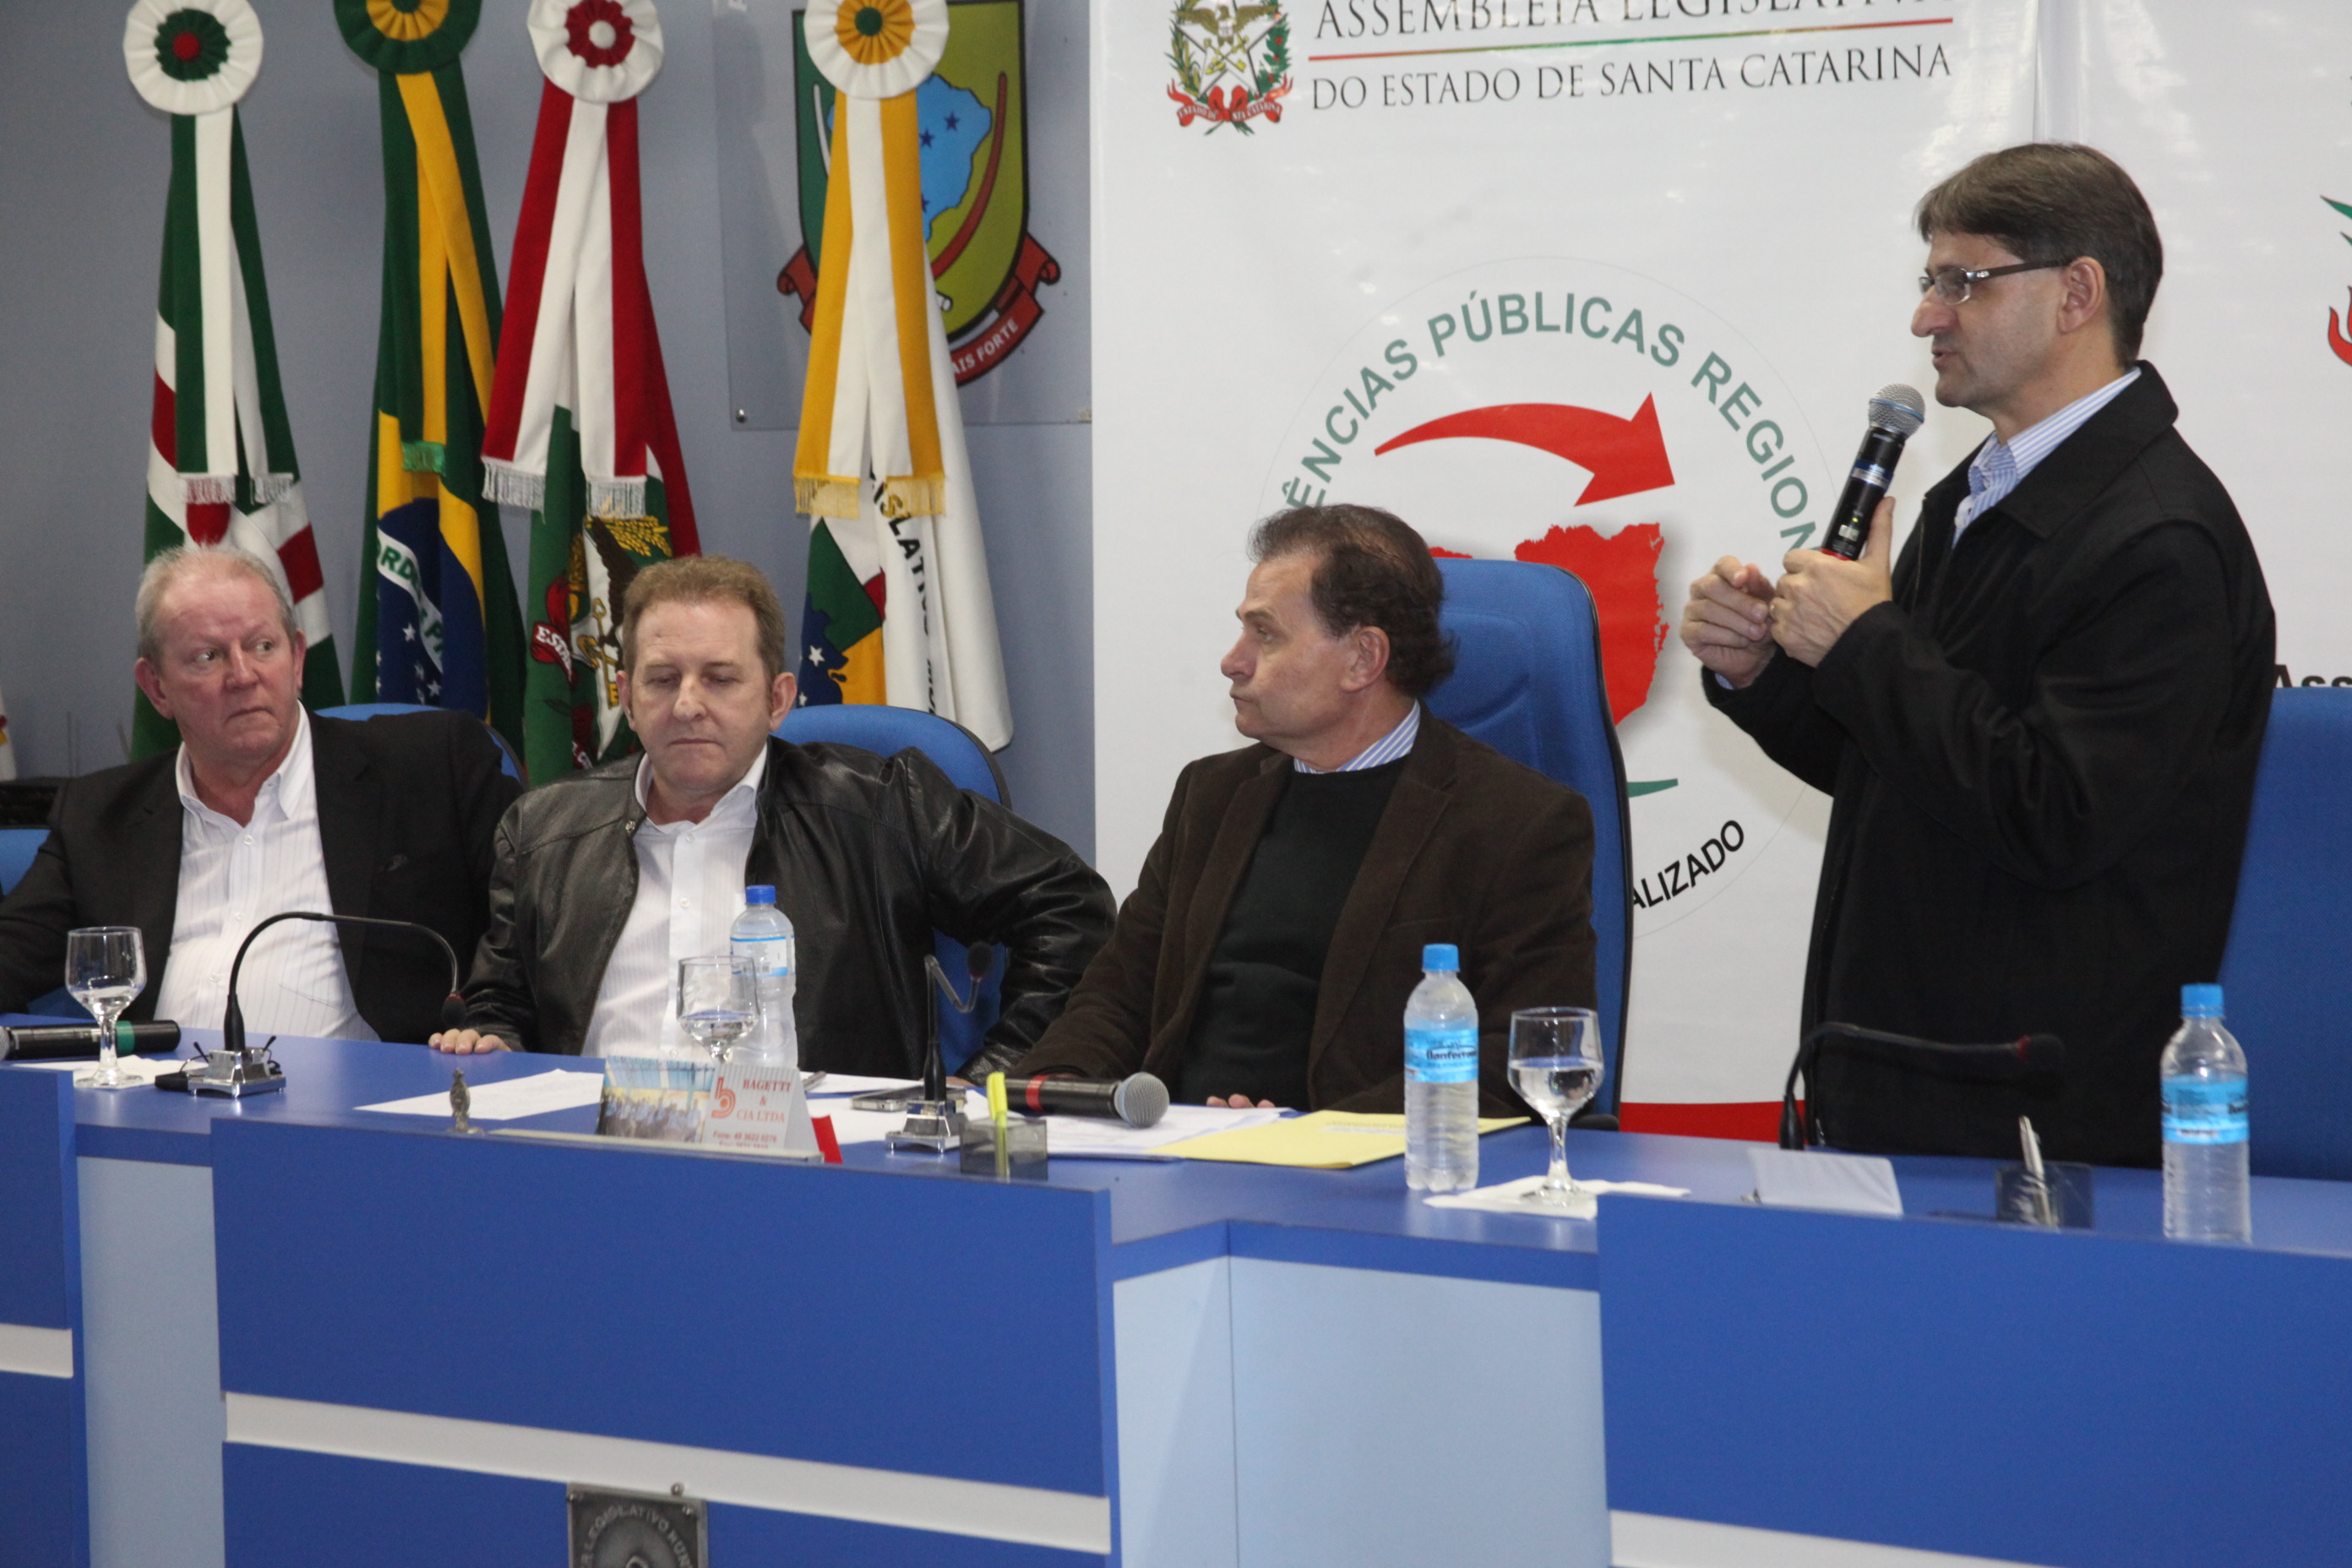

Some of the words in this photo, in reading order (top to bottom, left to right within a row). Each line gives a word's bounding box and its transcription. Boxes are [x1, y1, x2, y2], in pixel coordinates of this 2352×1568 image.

[1312, 76, 1367, 110] DO
[1382, 67, 1521, 107] ESTADO
[1537, 64, 1585, 100] DE
[1600, 57, 1727, 96] SANTA
[1740, 43, 1952, 88] CATARINA
[976, 318, 1019, 362] FORTE
[1428, 290, 1685, 368] PÚBLICAS
[743, 1079, 792, 1093] BAGETTI
[736, 1109, 754, 1121] CIA
